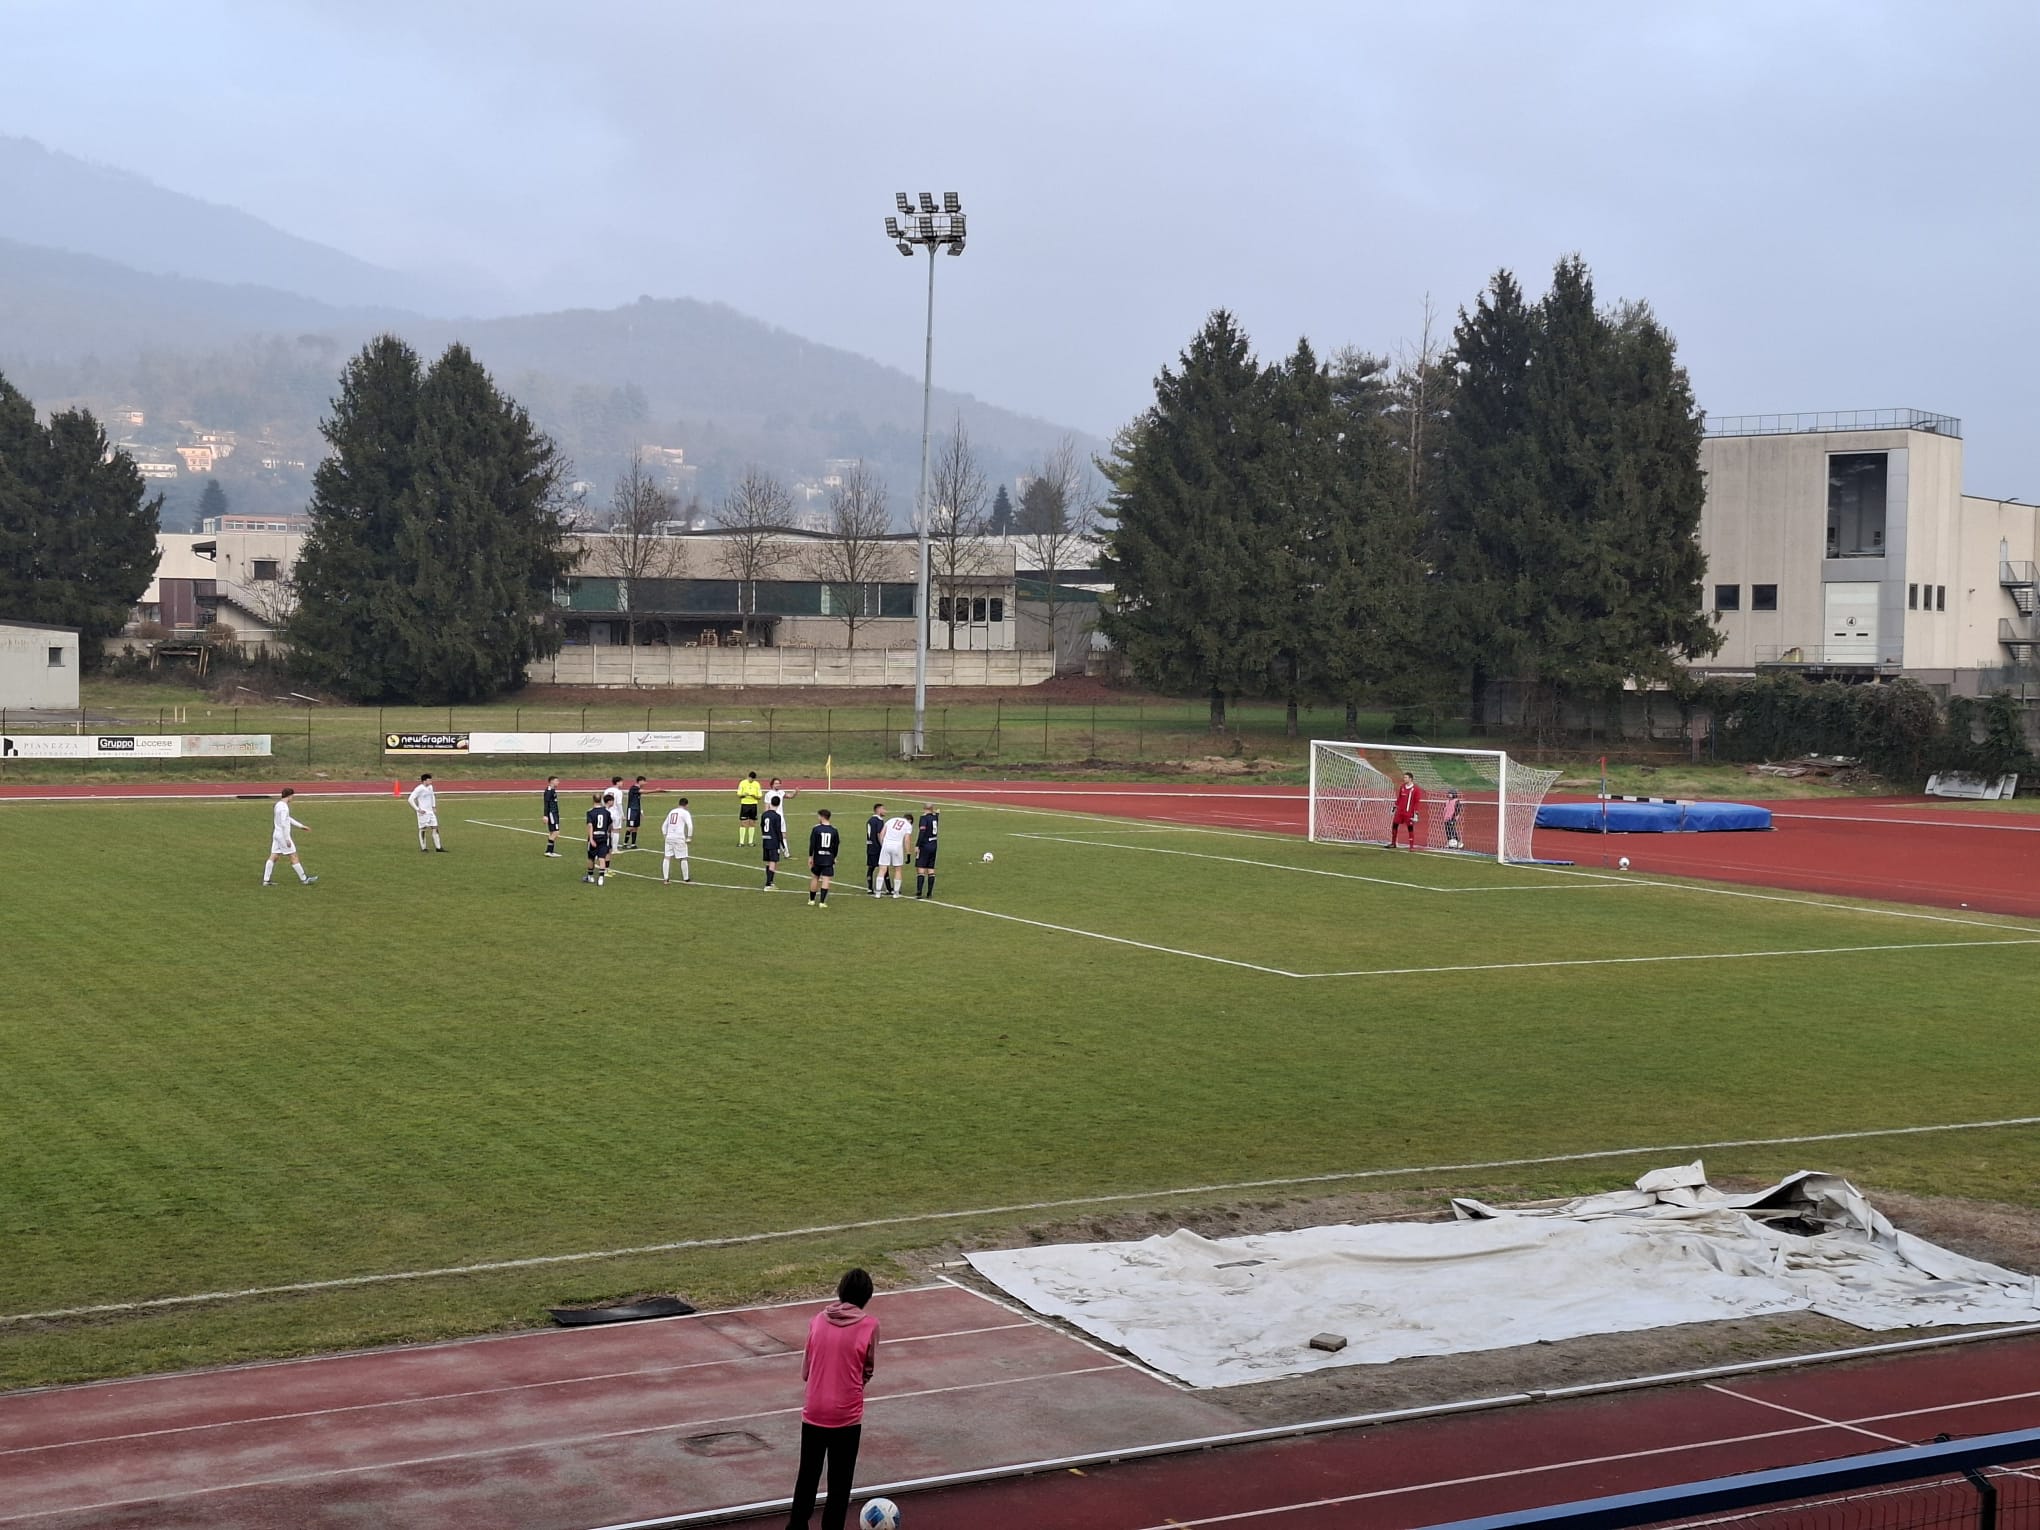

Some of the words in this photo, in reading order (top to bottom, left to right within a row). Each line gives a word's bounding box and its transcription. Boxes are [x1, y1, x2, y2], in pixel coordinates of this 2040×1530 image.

[100, 739, 134, 749] Gruppo
[401, 735, 456, 744] newGraphic
[670, 812, 678, 824] 10
[892, 819, 905, 831] 19
[820, 832, 832, 848] 10
